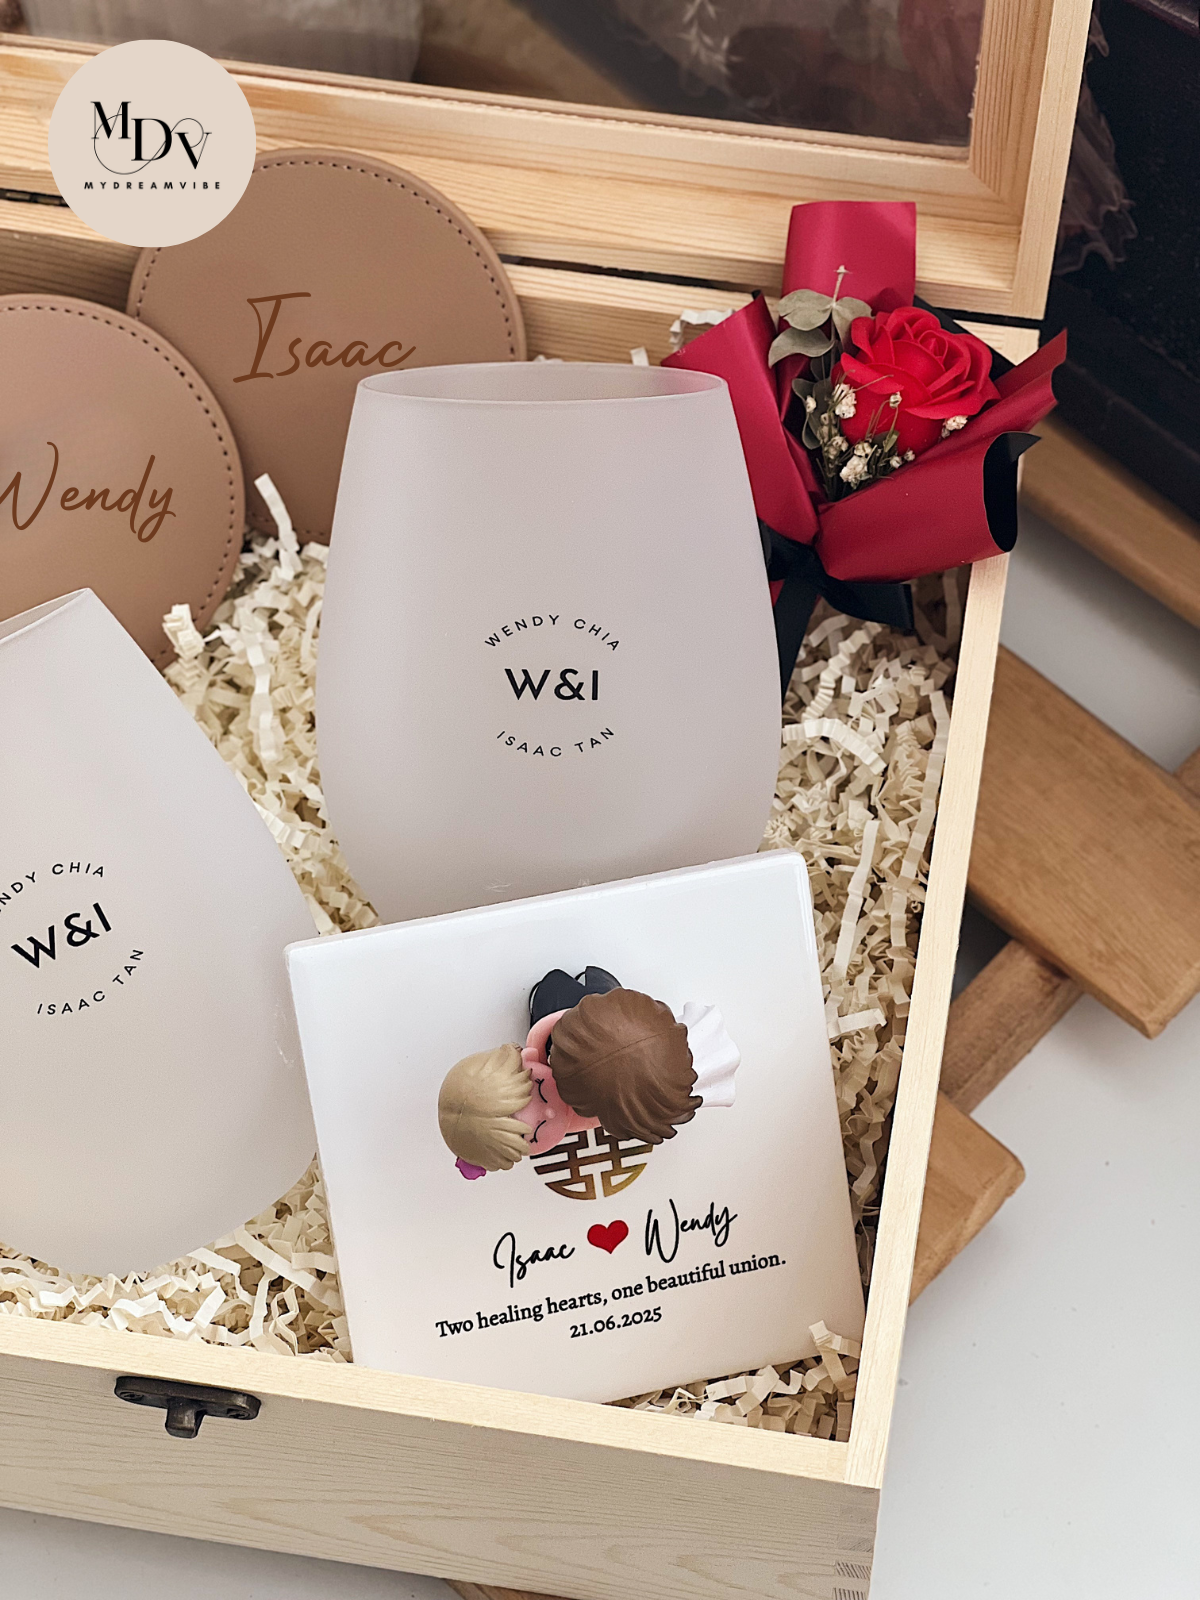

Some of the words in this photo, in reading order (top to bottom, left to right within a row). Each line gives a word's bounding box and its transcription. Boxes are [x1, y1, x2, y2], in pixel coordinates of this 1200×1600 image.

[232, 291, 417, 384] Isaac
[0, 441, 177, 543] Wendy
[484, 614, 560, 648] WENDY
[573, 618, 620, 651] CHIA
[504, 667, 599, 701] W&I
[496, 730, 562, 757] ISAAC
[574, 727, 615, 753] TAN
[0, 871, 36, 913] NDY
[51, 861, 104, 878] CHIA
[10, 902, 112, 969] W&I
[36, 990, 106, 1015] ISAAC
[112, 949, 144, 986] TAN
[493, 1232, 576, 1288] Isaac
[645, 1198, 738, 1264] Wendy
[435, 1319, 474, 1338] Two
[477, 1303, 544, 1330] healing
[545, 1290, 608, 1316] hearts,
[611, 1283, 644, 1301] one
[645, 1260, 726, 1294] beautiful
[729, 1254, 787, 1277] union.
[569, 1306, 663, 1339] 21.06.2025
